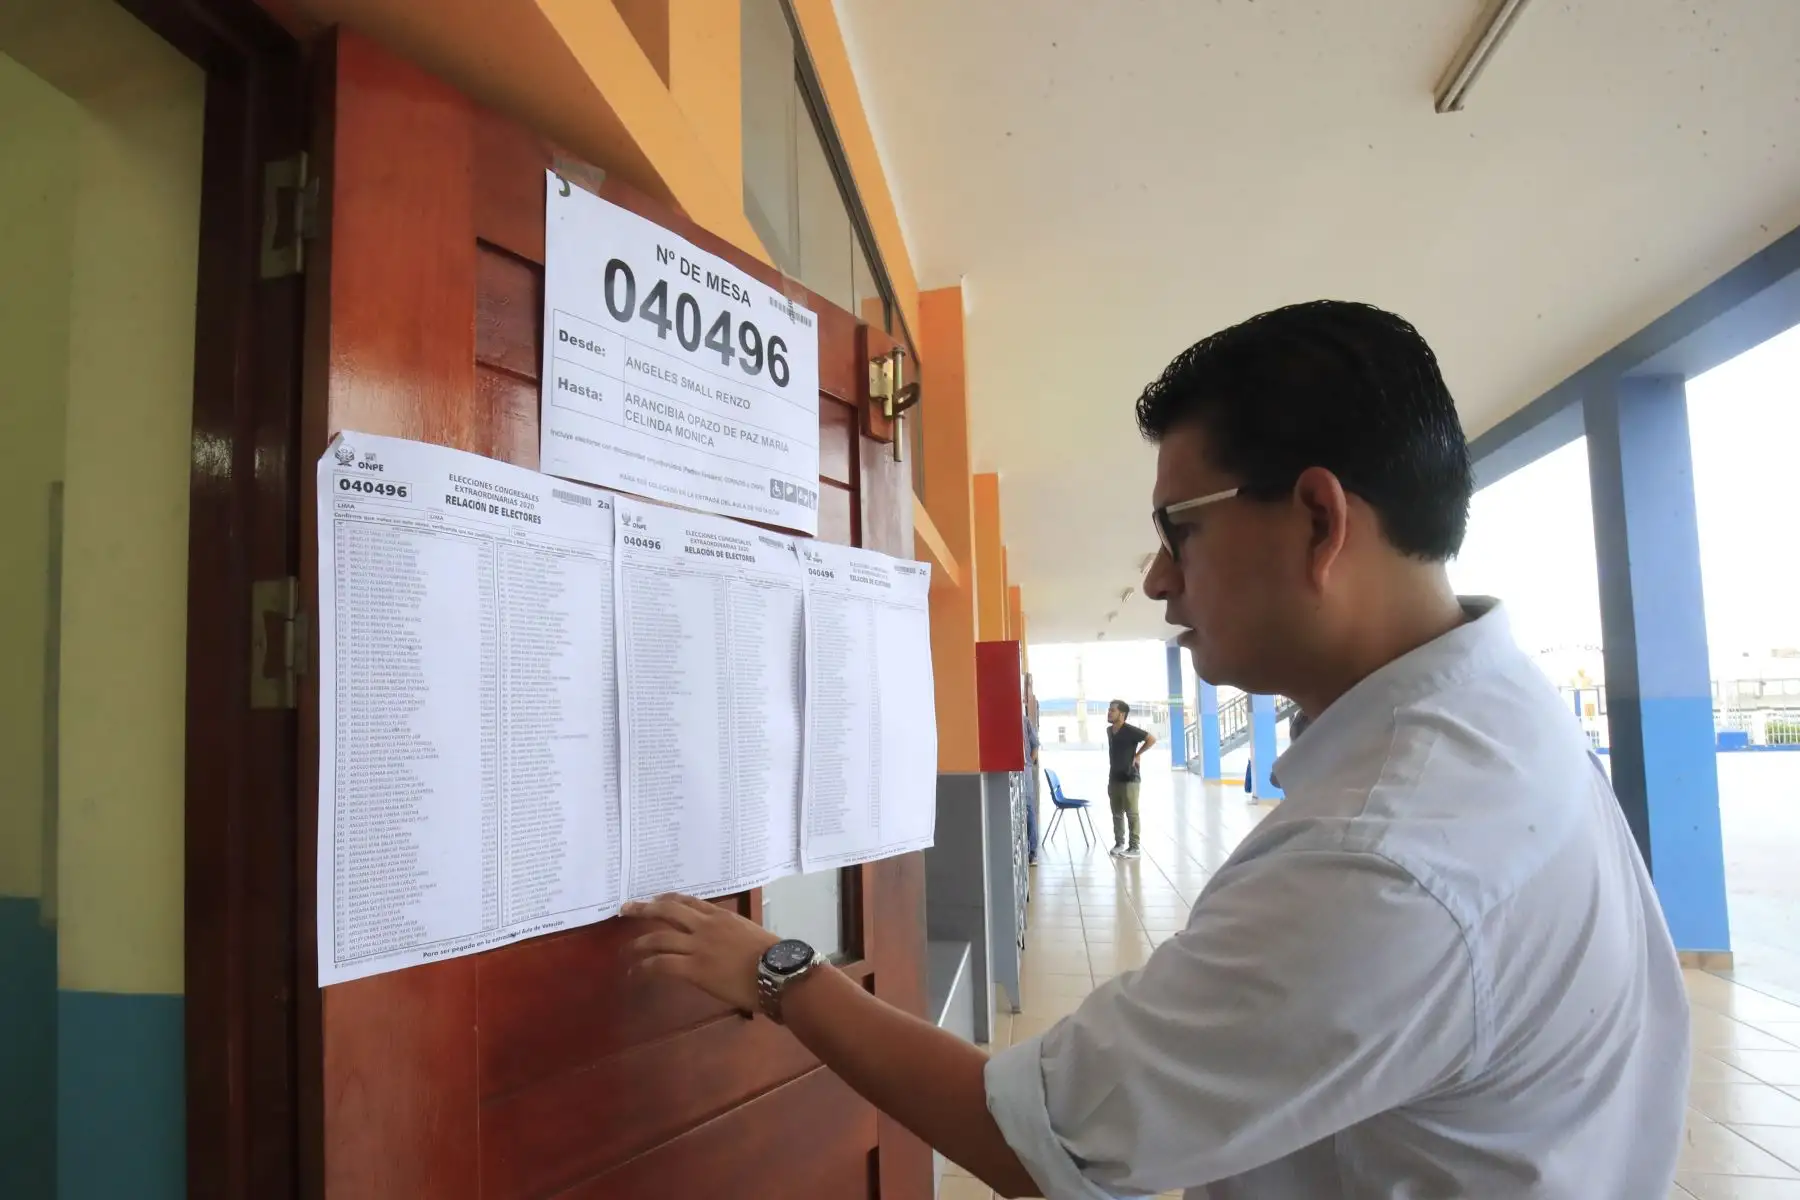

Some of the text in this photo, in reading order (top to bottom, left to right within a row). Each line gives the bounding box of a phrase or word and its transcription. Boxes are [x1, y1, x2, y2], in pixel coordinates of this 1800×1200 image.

[680, 256, 700, 283] DE
[706, 271, 752, 307] MESA
[604, 258, 790, 388] 040496
[559, 329, 606, 357] Desde:
[558, 376, 603, 402] Hasta:
[626, 355, 751, 410] ANGELES SMALL RENZO
[625, 392, 789, 453] ARANCIBIA OPAZO DE PAZ MARIA
[625, 409, 715, 448] CELINDA MONICA
[358, 461, 384, 472] ONPE
[339, 478, 407, 498] 040496
[448, 473, 540, 503] ELECCIONES CONGRESALES
[454, 484, 535, 510] EXTRAORDINARIAS 2020
[488, 504, 500, 515] DE
[501, 507, 542, 525] ELECTORES
[597, 499, 610, 510] 2a
[623, 535, 661, 550] 040496
[685, 529, 717, 540] ELECCIONES
[716, 550, 724, 558] DE
[725, 552, 756, 563] ELECTORES
[808, 567, 835, 579] 040496
[422, 950, 439, 959] Para
[485, 936, 491, 945] la
